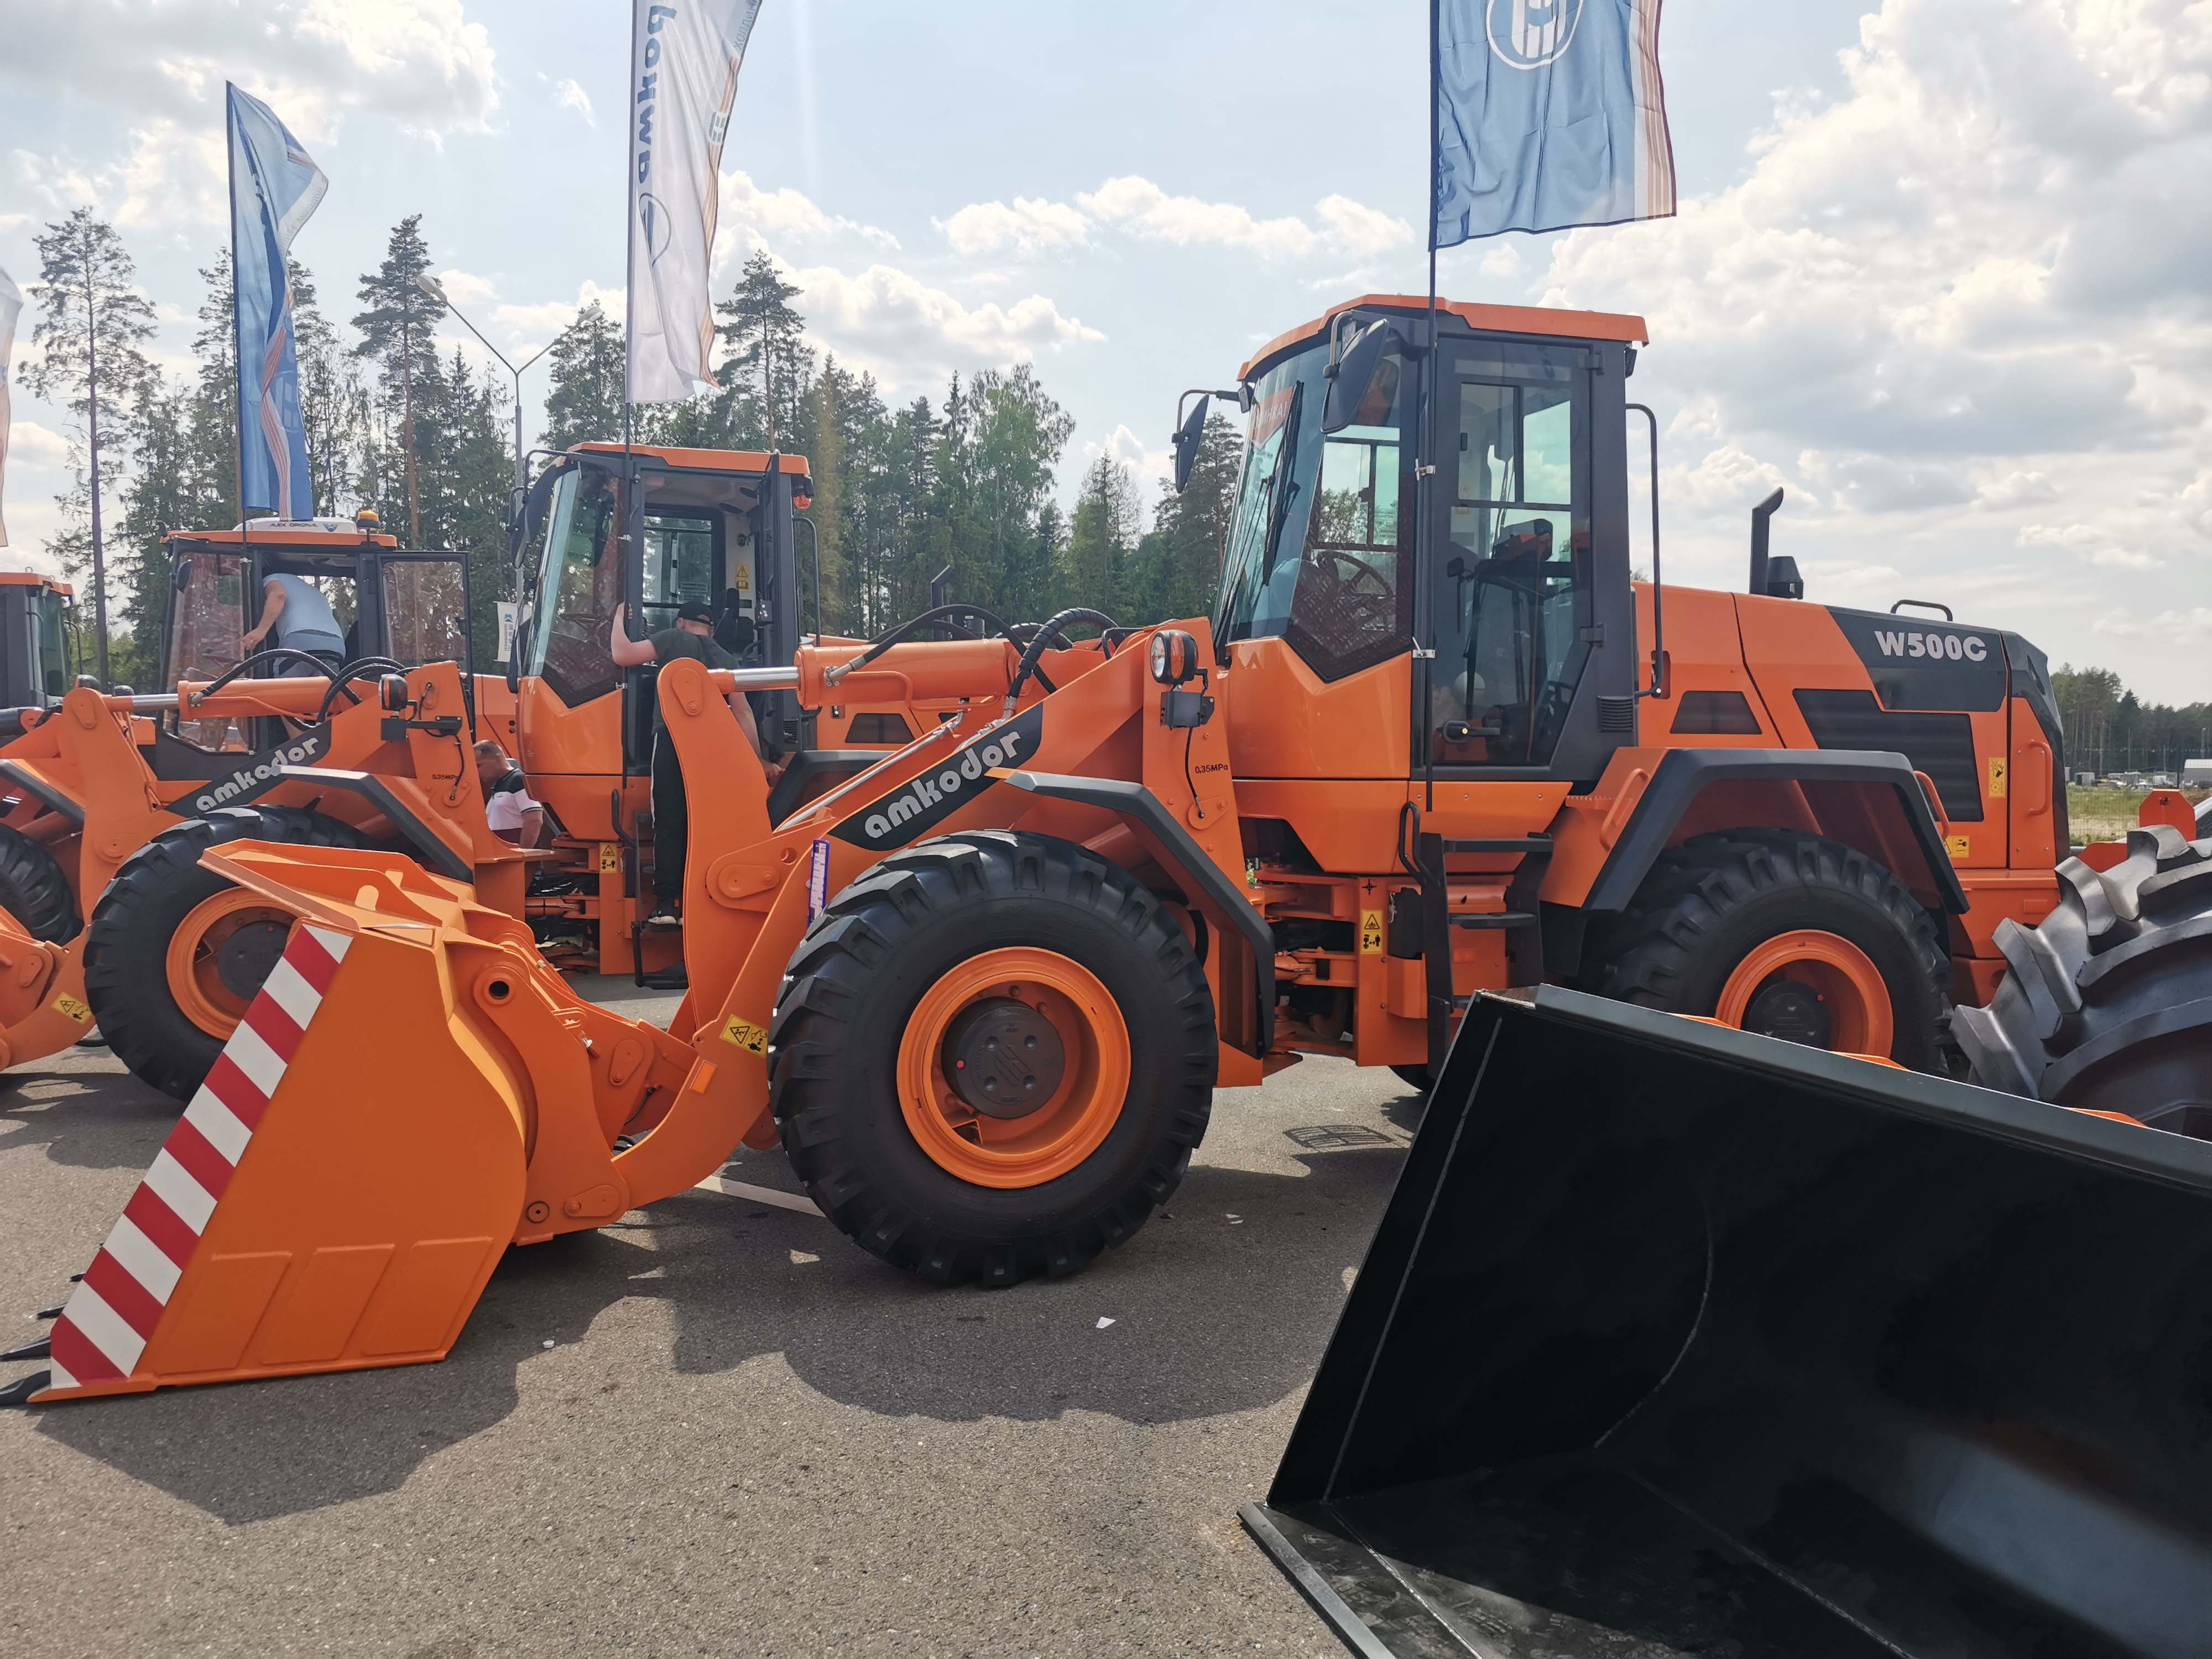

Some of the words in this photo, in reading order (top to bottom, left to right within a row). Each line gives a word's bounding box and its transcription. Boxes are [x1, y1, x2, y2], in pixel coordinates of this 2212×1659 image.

[734, 0, 758, 51] ХОЛДИН
[1874, 630, 1987, 662] W500C
[196, 737, 319, 811] amkodor
[864, 731, 1021, 839] amkodor
[1194, 763, 1229, 774] 0,35MPa
